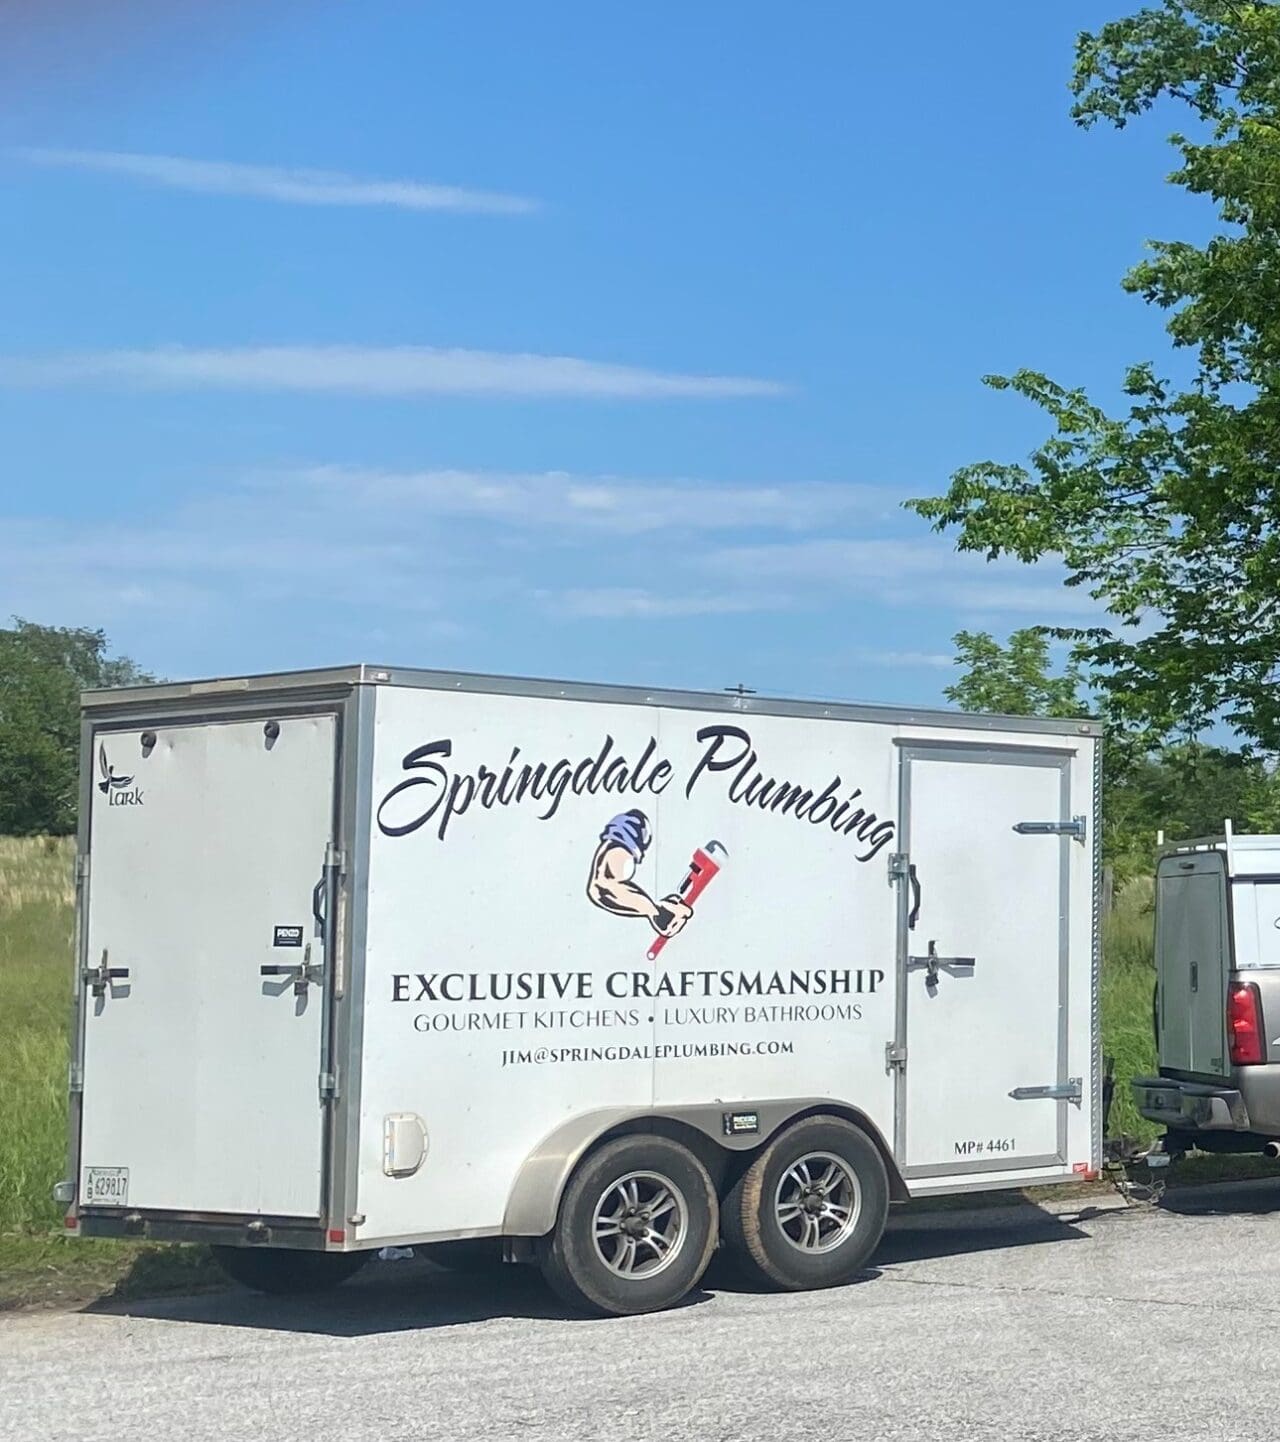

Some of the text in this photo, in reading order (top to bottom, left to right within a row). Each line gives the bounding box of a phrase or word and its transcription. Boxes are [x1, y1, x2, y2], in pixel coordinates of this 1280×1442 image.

[376, 724, 896, 863] Springdale Plumbing
[390, 968, 886, 1003] EXCLUSIVE CRAFTSMANSHIP
[413, 1003, 863, 1033] GOURMET KITCHENS LUXURY BATHROOMS
[501, 1040, 795, 1068] JIM@SPRINGDALEPLUMBING.COM
[953, 1137, 1016, 1155] MP# 4461
[95, 1177, 127, 1196] 629817
